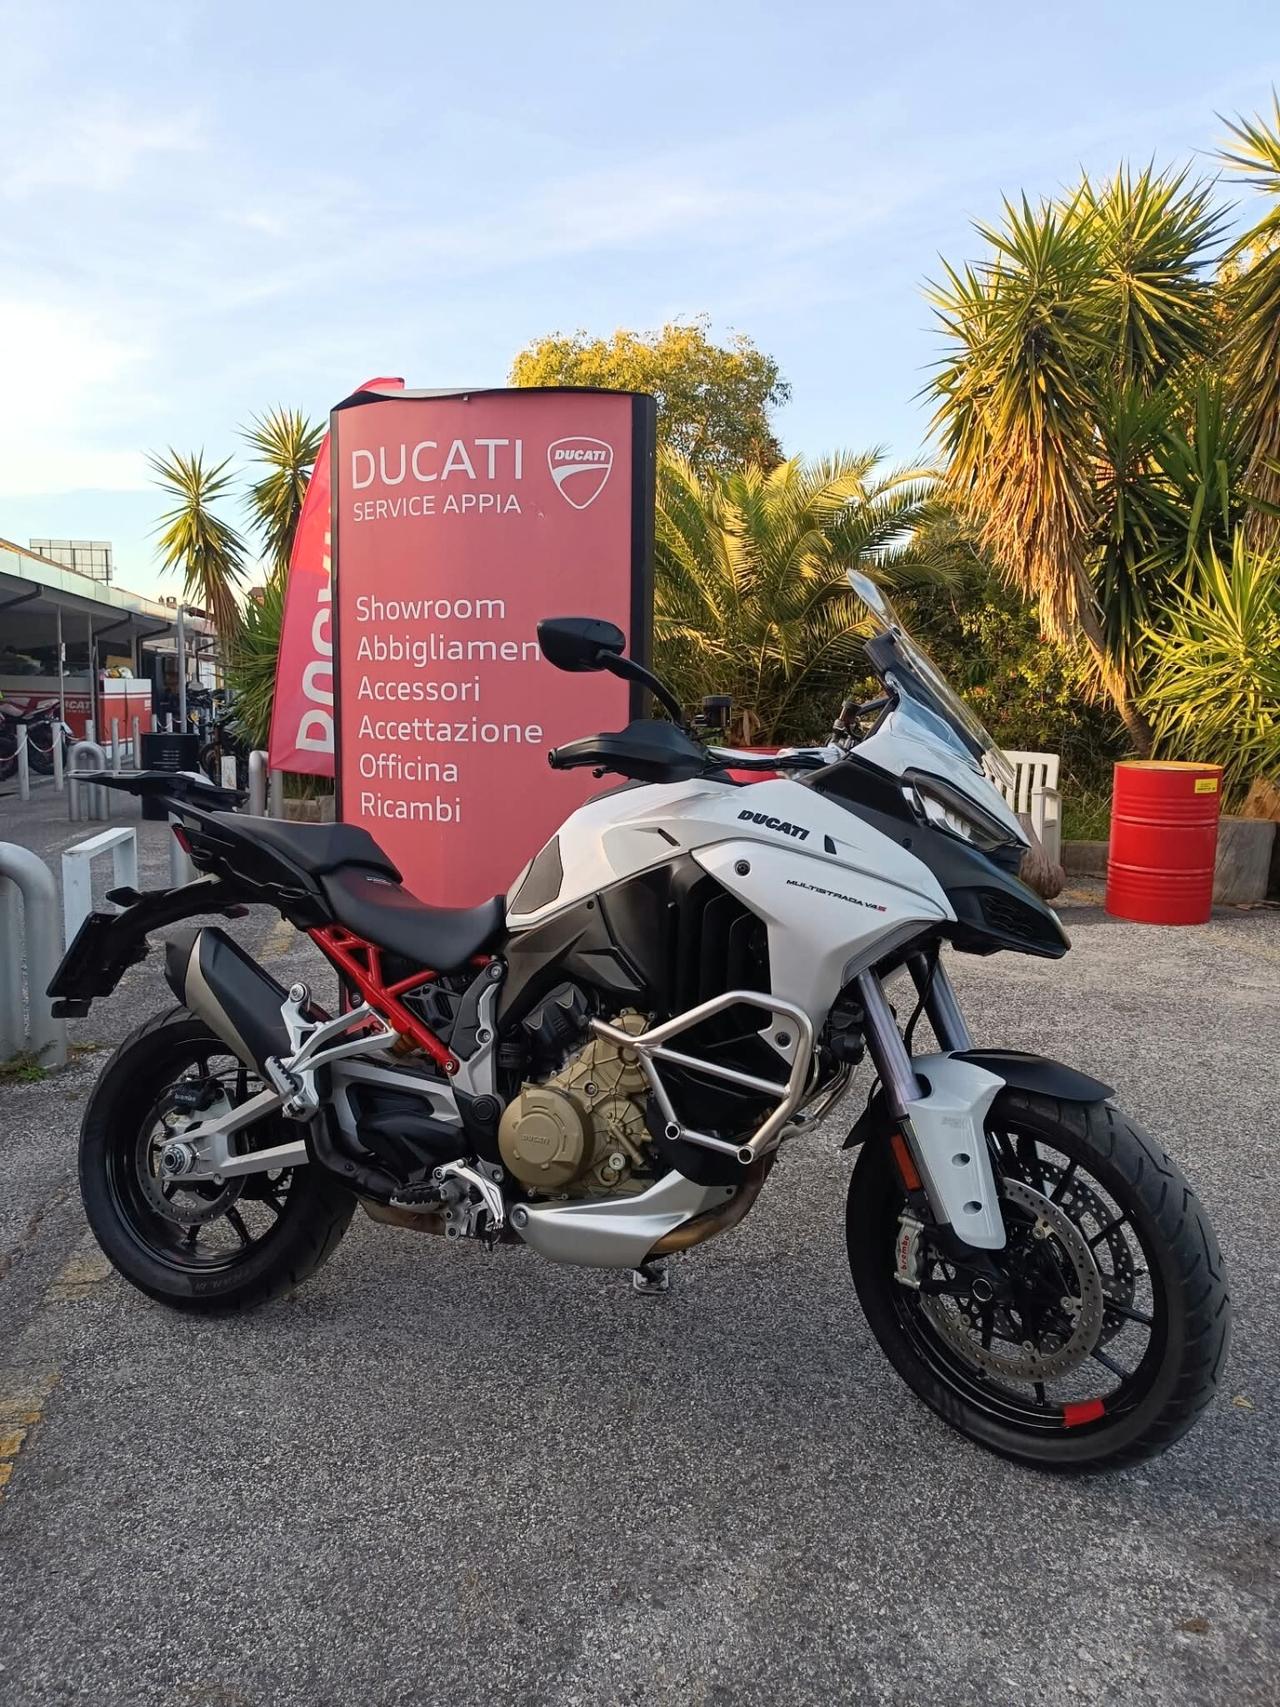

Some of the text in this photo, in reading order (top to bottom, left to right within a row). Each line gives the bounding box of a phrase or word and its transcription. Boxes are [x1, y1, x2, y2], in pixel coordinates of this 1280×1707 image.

[351, 438, 523, 490] DUCATI
[554, 449, 607, 461] DUCATI
[353, 493, 522, 522] SERVICE APPIA
[356, 594, 506, 622] Showroom
[356, 632, 540, 668] Abbigliamen
[357, 675, 481, 703] Accessori
[358, 714, 544, 744] Accettazione
[359, 752, 459, 784] Officina
[361, 791, 461, 823] Ricambi
[737, 809, 810, 841] DUCATI
[785, 879, 864, 907] MULTISTRADA
[901, 1235, 910, 1270] brembo
